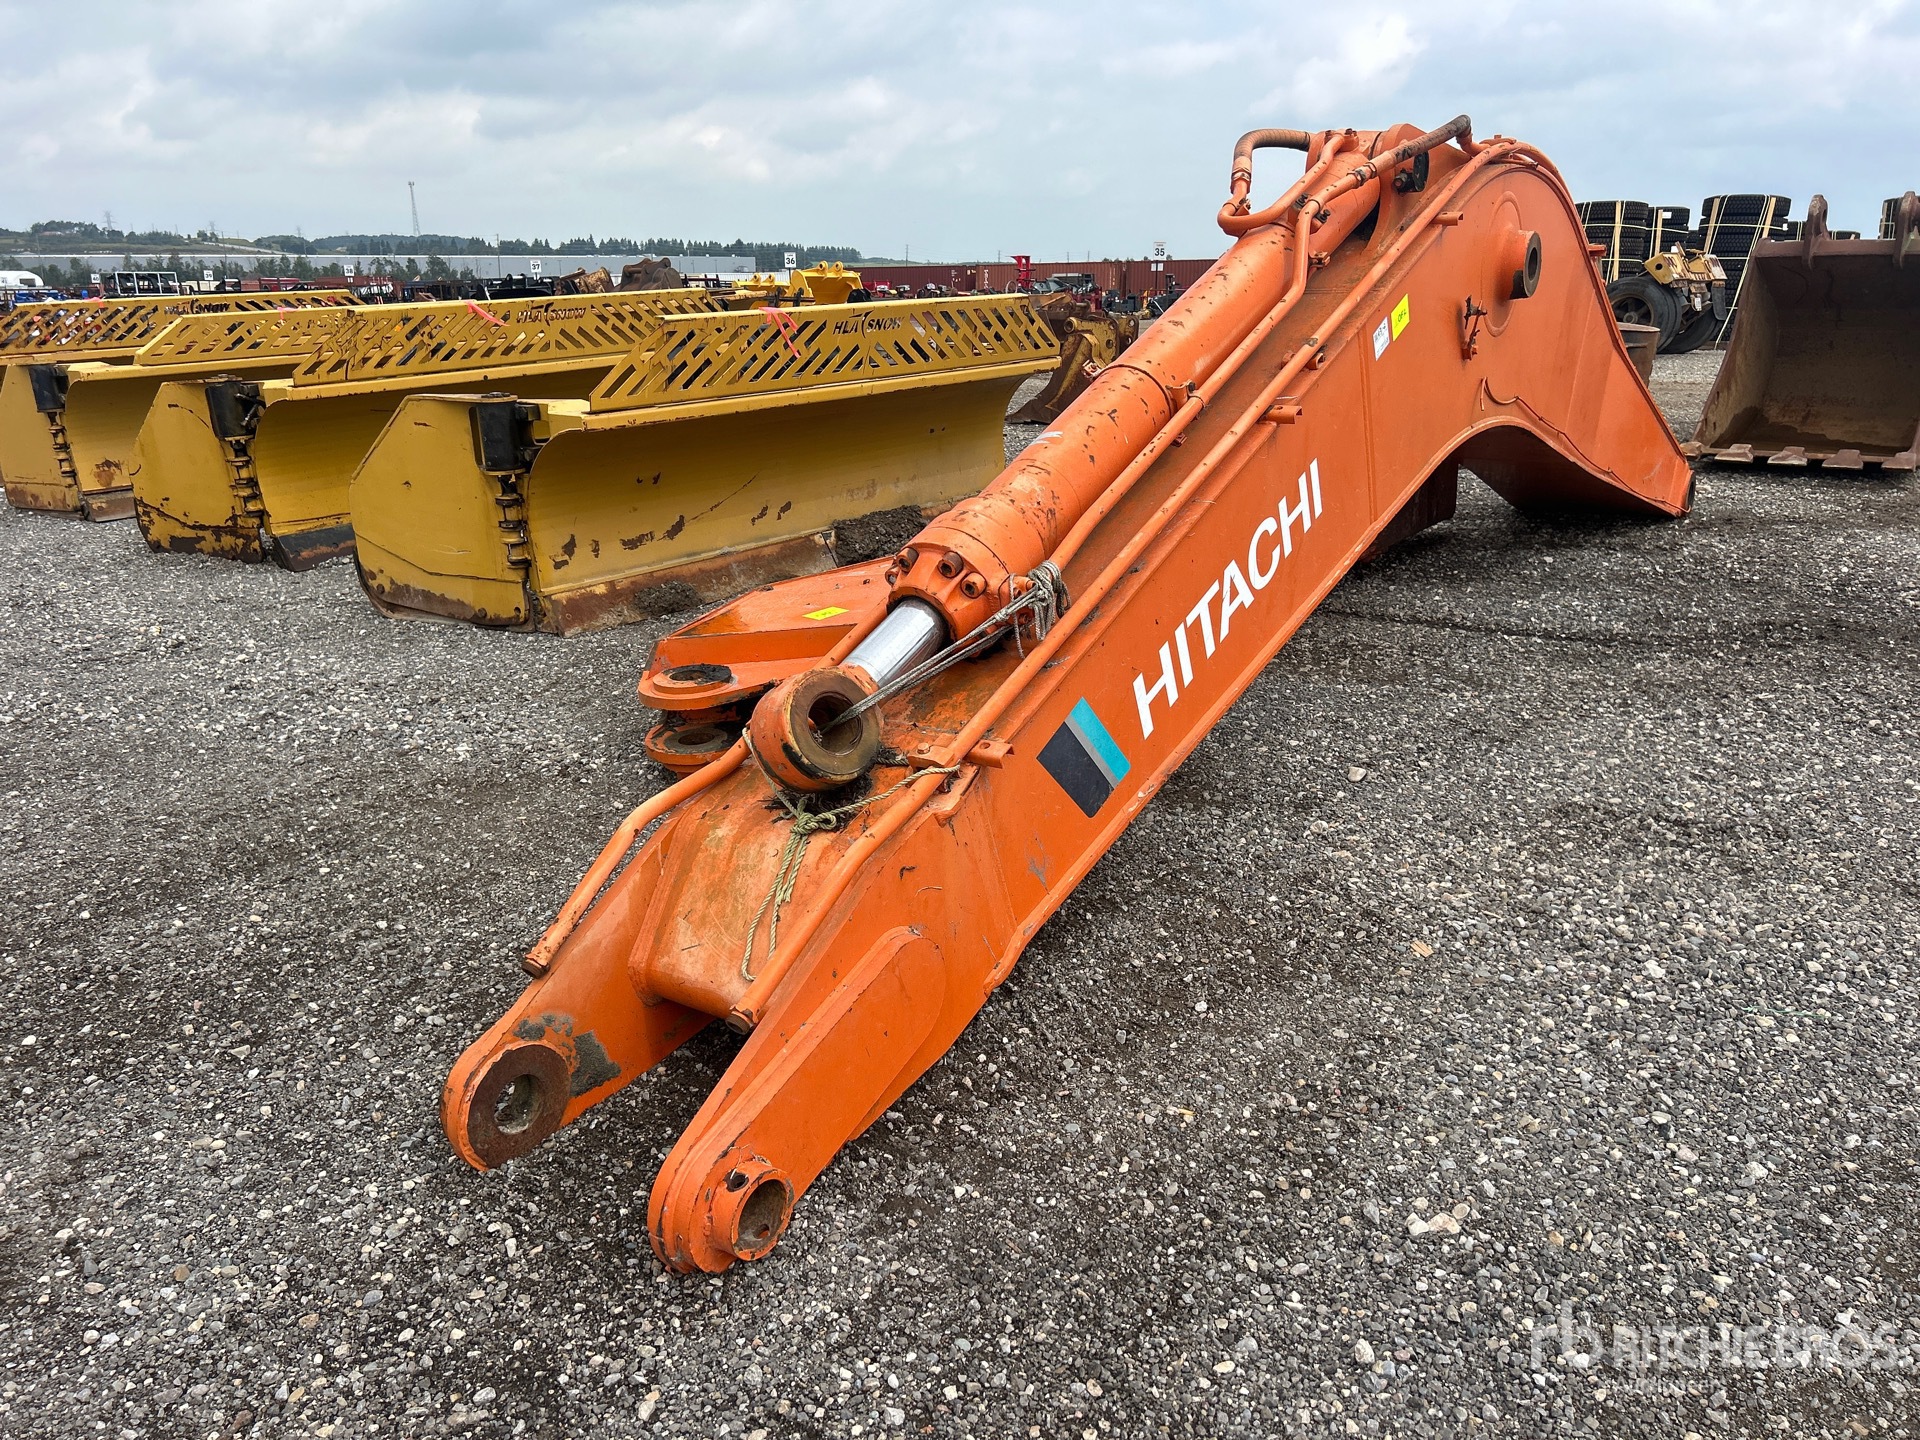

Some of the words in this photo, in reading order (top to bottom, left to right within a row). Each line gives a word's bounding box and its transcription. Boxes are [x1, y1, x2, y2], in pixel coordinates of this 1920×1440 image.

[1154, 247, 1165, 257] 35
[785, 257, 796, 265] 36
[516, 309, 542, 323] HLA
[549, 307, 586, 321] SNOW
[832, 320, 859, 335] HLA
[867, 316, 905, 331] SNOW
[1132, 457, 1323, 741] HITACHI
